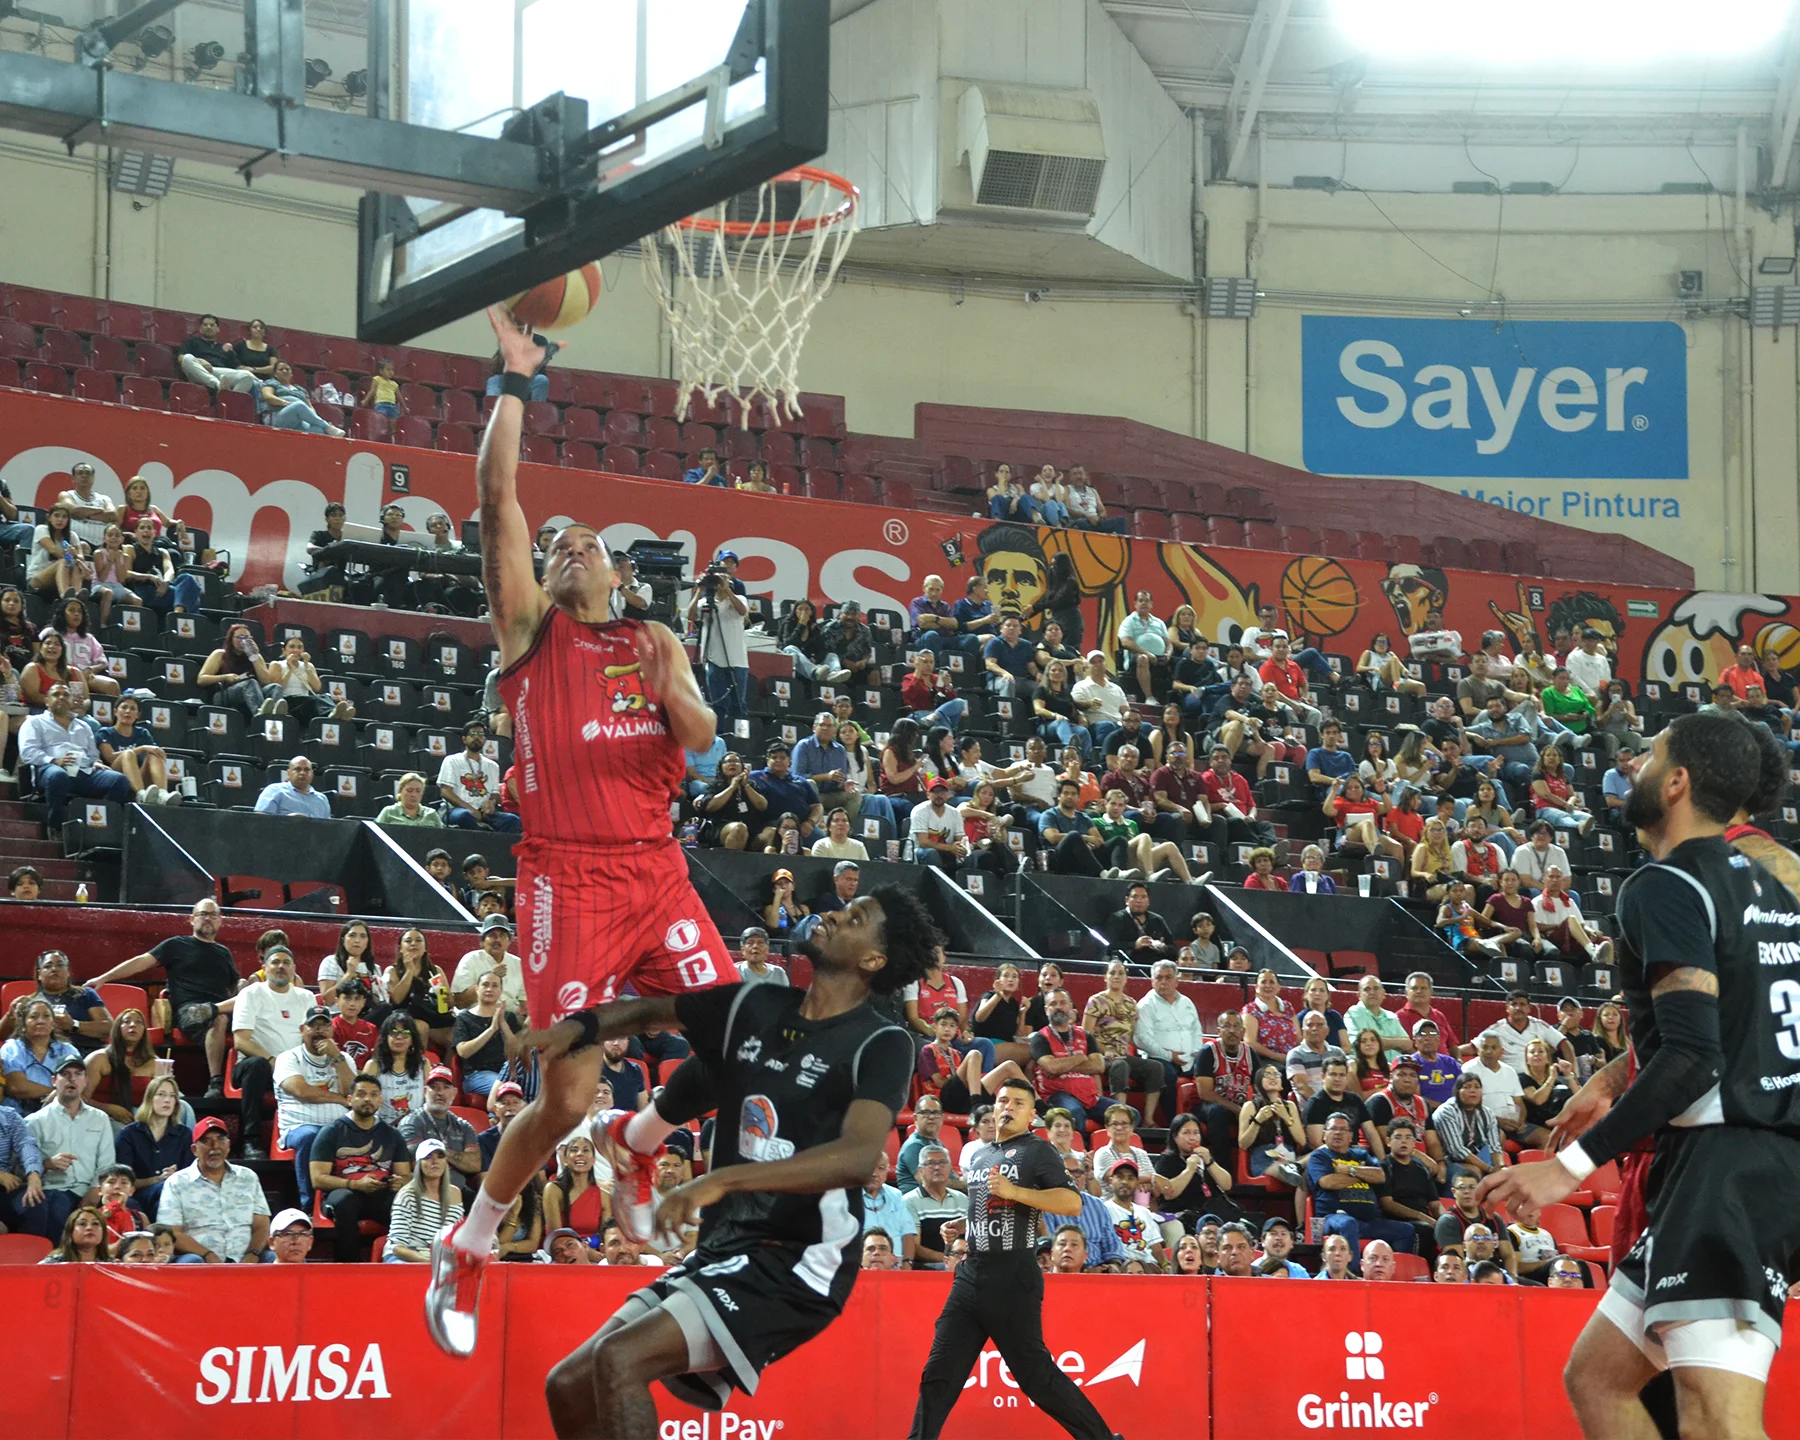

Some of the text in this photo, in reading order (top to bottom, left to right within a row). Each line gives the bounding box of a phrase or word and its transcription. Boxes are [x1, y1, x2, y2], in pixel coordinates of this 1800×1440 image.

[394, 472, 405, 486] 9
[1563, 491, 1680, 518] Pintura
[946, 543, 956, 555] 9
[1532, 592, 1541, 605] 8
[967, 1164, 1019, 1183] BACPA
[1656, 1272, 1689, 1290] ADX
[712, 1287, 740, 1312] ADX
[195, 1343, 392, 1405] SIMSA
[993, 1395, 1018, 1407] on
